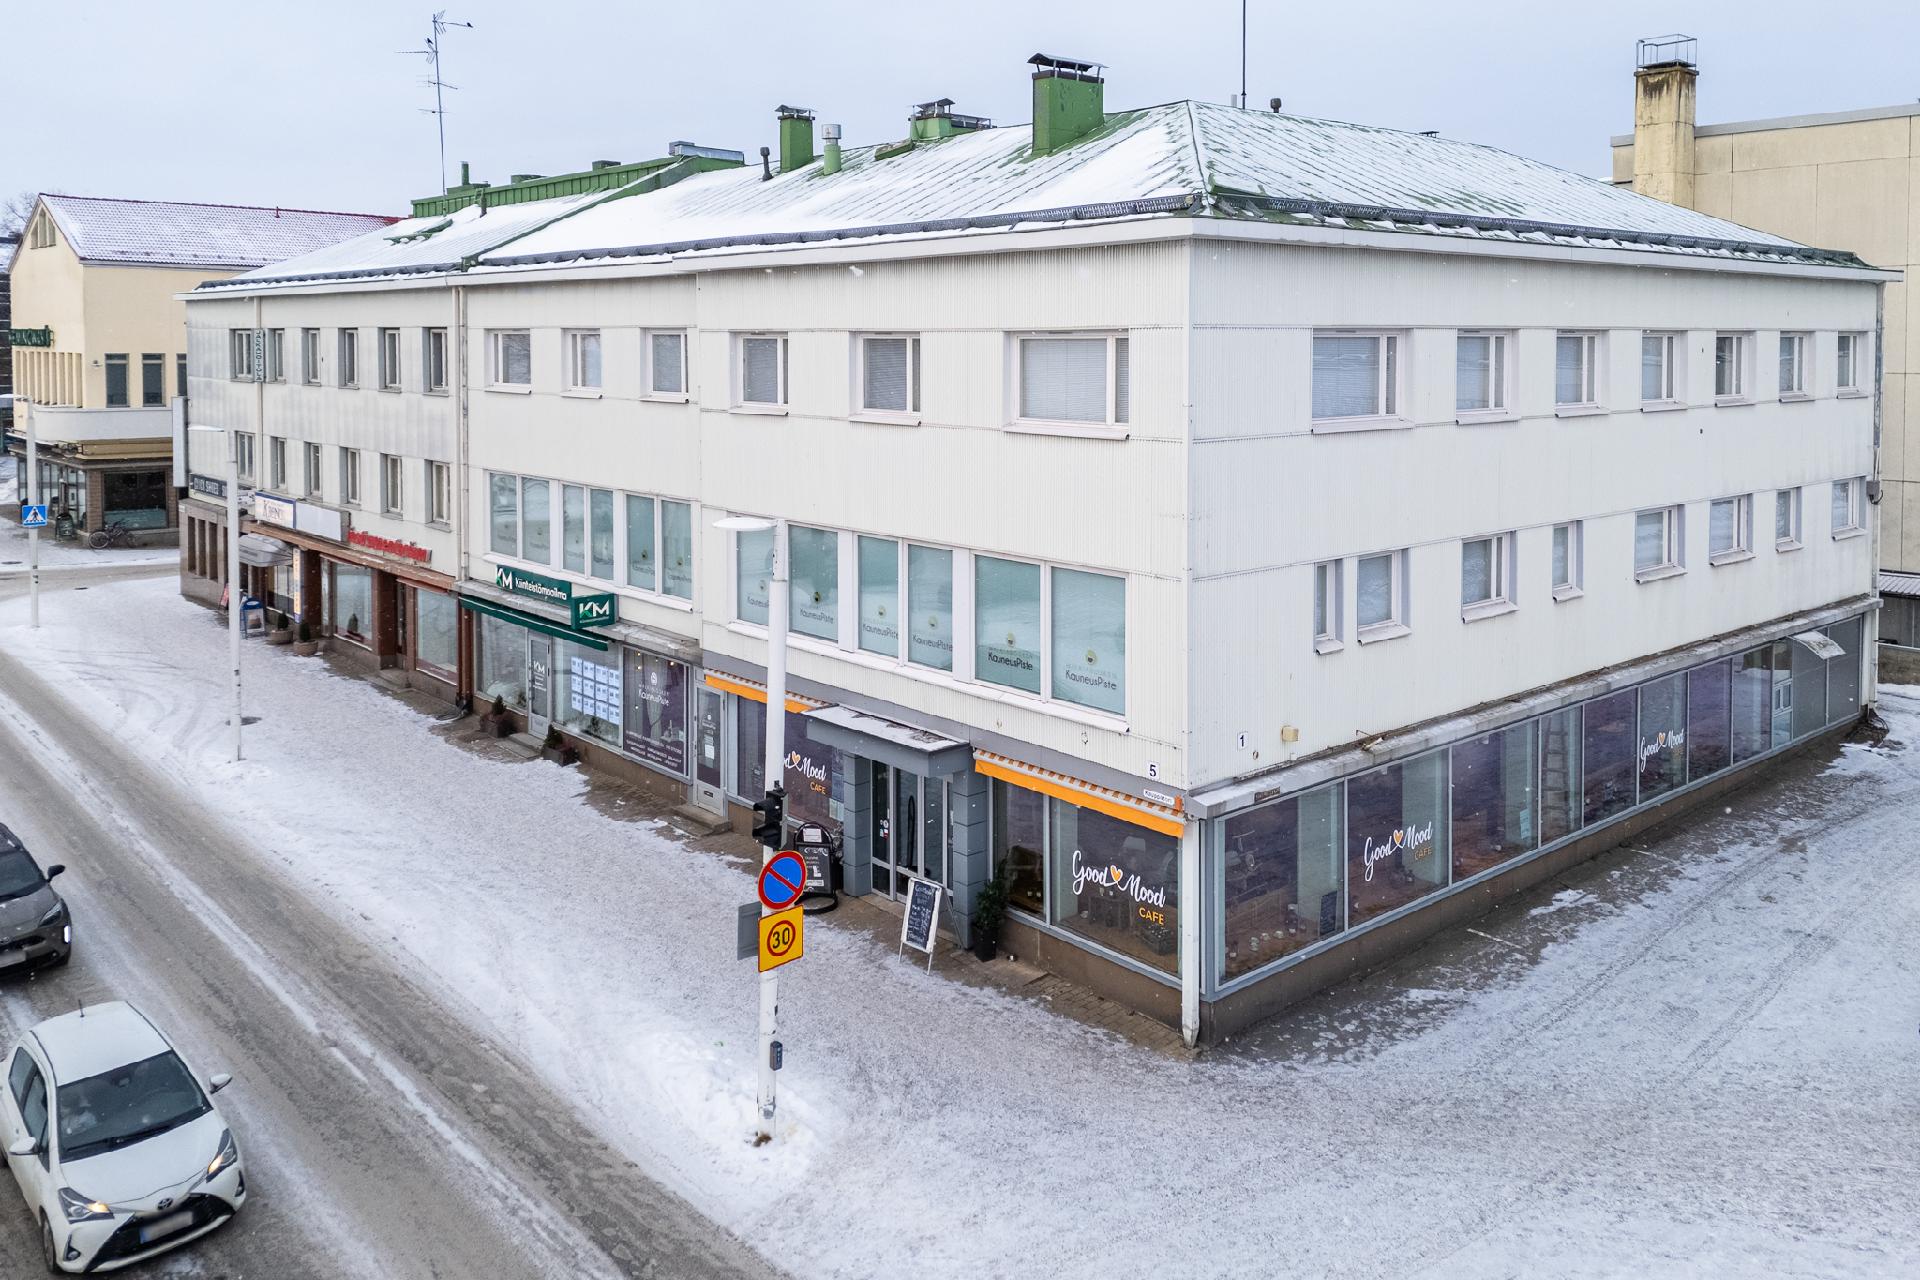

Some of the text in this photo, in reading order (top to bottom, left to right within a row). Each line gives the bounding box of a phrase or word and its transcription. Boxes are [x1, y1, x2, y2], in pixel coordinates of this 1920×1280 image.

[496, 567, 513, 590] KM
[579, 600, 609, 619] KM
[988, 652, 1033, 671] KauneusPiste
[1065, 669, 1117, 690] KauneusPiste
[1239, 734, 1245, 747] 1
[1640, 728, 1685, 773] Good Mood
[799, 757, 827, 781] Mood
[1149, 764, 1157, 777] 5
[810, 781, 827, 795] CAFE
[1364, 821, 1433, 882] Good Mood
[1415, 846, 1433, 861] CAFE
[1072, 850, 1166, 908] Good Mood
[1138, 907, 1165, 925] CAFE
[772, 927, 790, 949] 30
